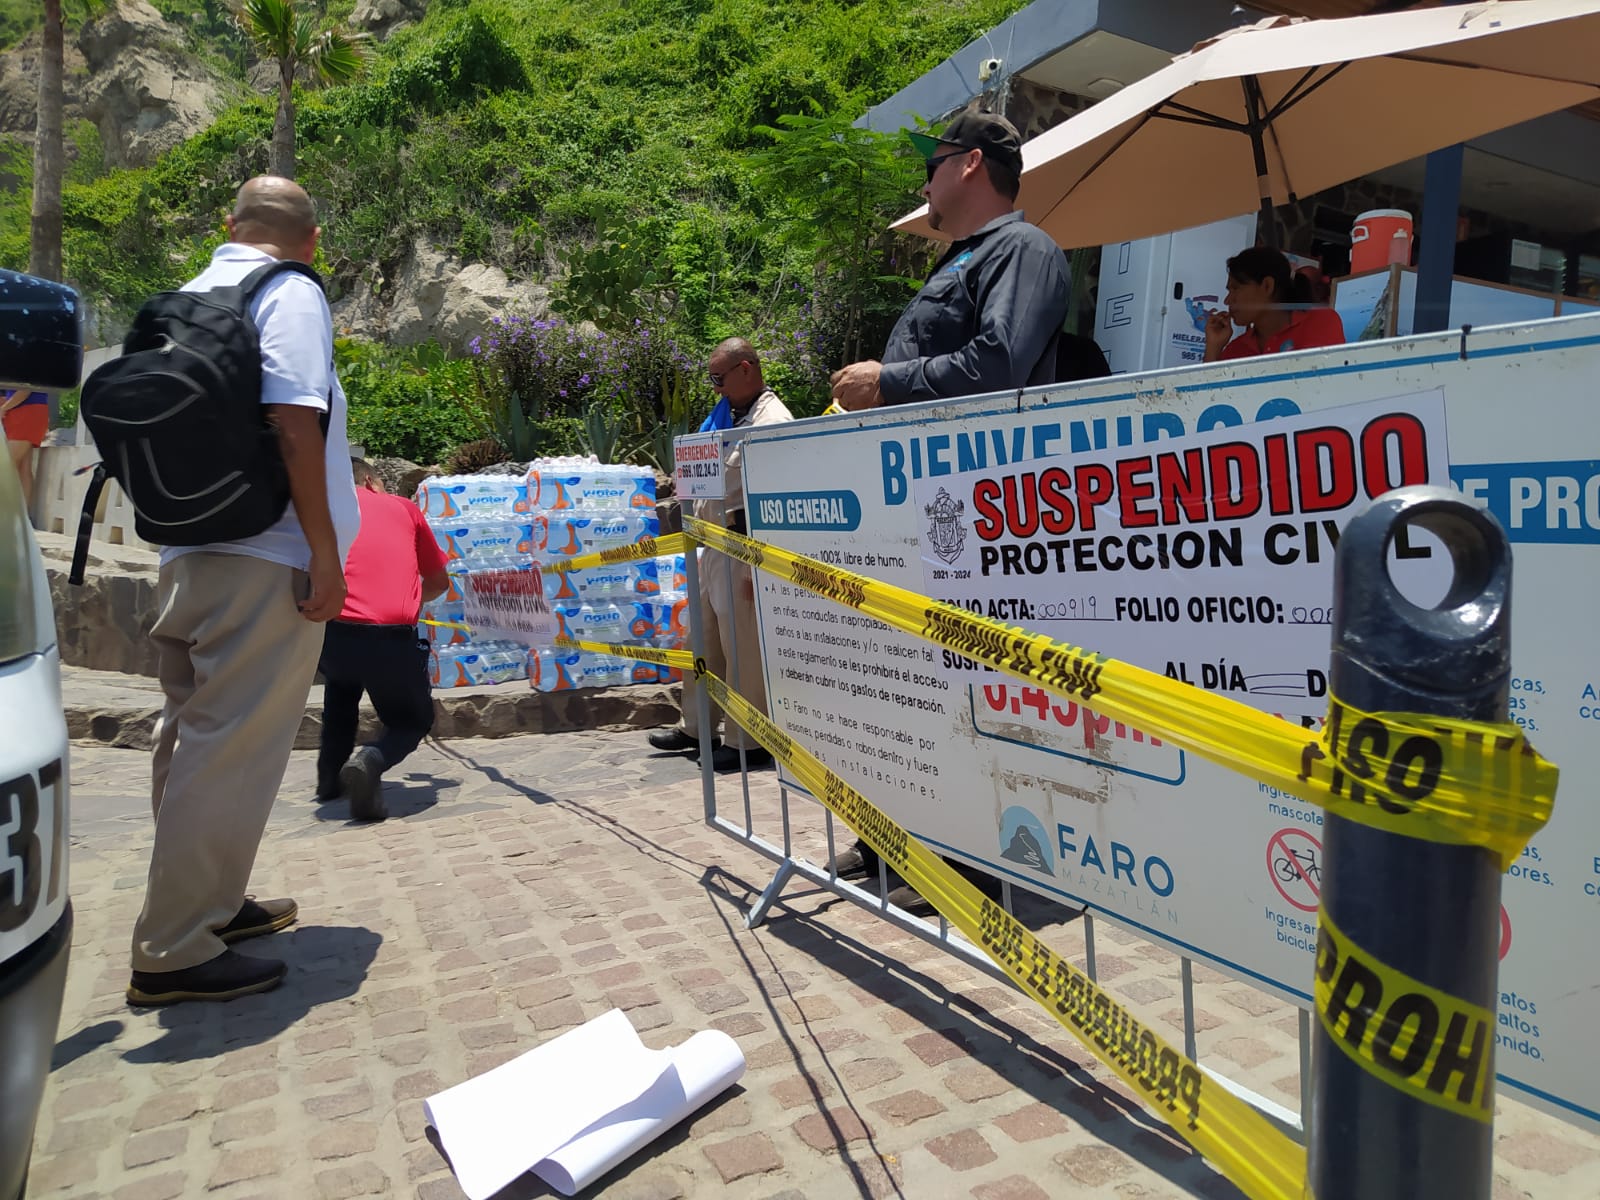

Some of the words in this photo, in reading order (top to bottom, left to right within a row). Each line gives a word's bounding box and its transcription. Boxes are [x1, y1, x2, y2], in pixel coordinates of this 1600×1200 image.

[675, 443, 719, 462] EMERGENCIAS
[973, 411, 1430, 541] SUSPENDIDO
[760, 499, 784, 524] USO
[786, 498, 849, 524] GENERAL
[820, 550, 841, 564] 100%
[843, 551, 862, 566] libre
[865, 551, 876, 566] de
[877, 552, 907, 568] humo.
[979, 527, 1245, 577] PROTECCION
[802, 609, 839, 624] conductas
[988, 598, 1036, 620] ACTA:
[1115, 596, 1180, 622] FOLIO
[1187, 595, 1284, 623] OFICIO:
[883, 643, 919, 660] realicen
[839, 659, 848, 670] se
[849, 657, 861, 673] les
[862, 662, 901, 681] prohibirá
[902, 668, 911, 682] el
[1201, 657, 1248, 692] DÍA
[1306, 668, 1331, 698] D
[838, 677, 850, 693] los
[850, 683, 877, 698] gastos
[879, 687, 890, 702] de
[891, 692, 946, 715] reparación.
[783, 697, 790, 710] El
[793, 700, 809, 716] Faro
[812, 709, 822, 720] no
[825, 712, 835, 723] se
[838, 713, 858, 730] hace
[862, 721, 914, 746] responsable
[919, 737, 936, 752] por
[846, 739, 852, 750] o
[855, 741, 877, 758] robos
[878, 746, 904, 767] dentro
[906, 758, 912, 771] y
[914, 756, 939, 777] fuera
[1057, 822, 1175, 898] FARO
[1506, 864, 1554, 886] ores.
[1061, 867, 1179, 925] MAZATLÁN
[1265, 906, 1316, 936] Ingresar
[1276, 928, 1318, 954] bicicle
[1496, 991, 1537, 1015] atos
[1498, 1012, 1540, 1038] altos
